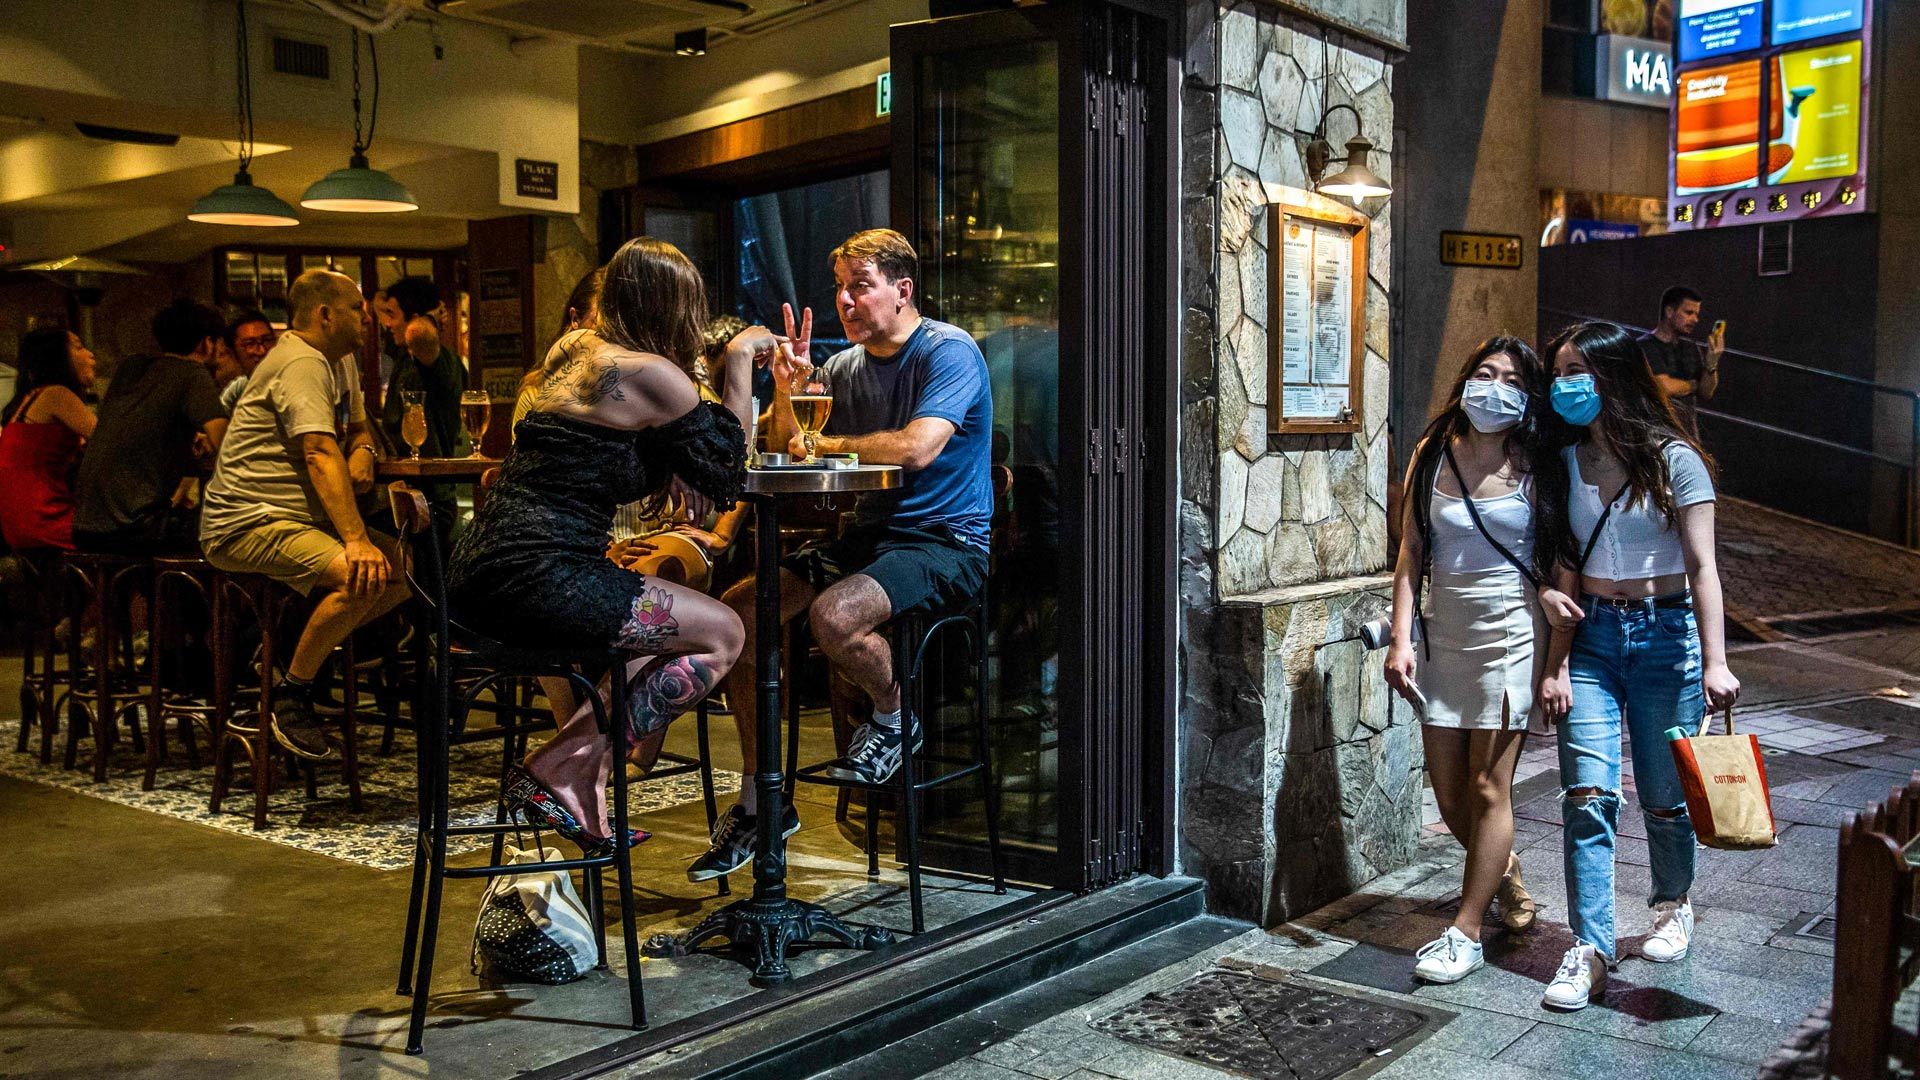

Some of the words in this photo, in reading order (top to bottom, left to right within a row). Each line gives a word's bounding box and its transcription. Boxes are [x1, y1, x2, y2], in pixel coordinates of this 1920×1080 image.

[1626, 49, 1672, 94] MA
[881, 75, 891, 112] E
[523, 164, 554, 175] PLACE
